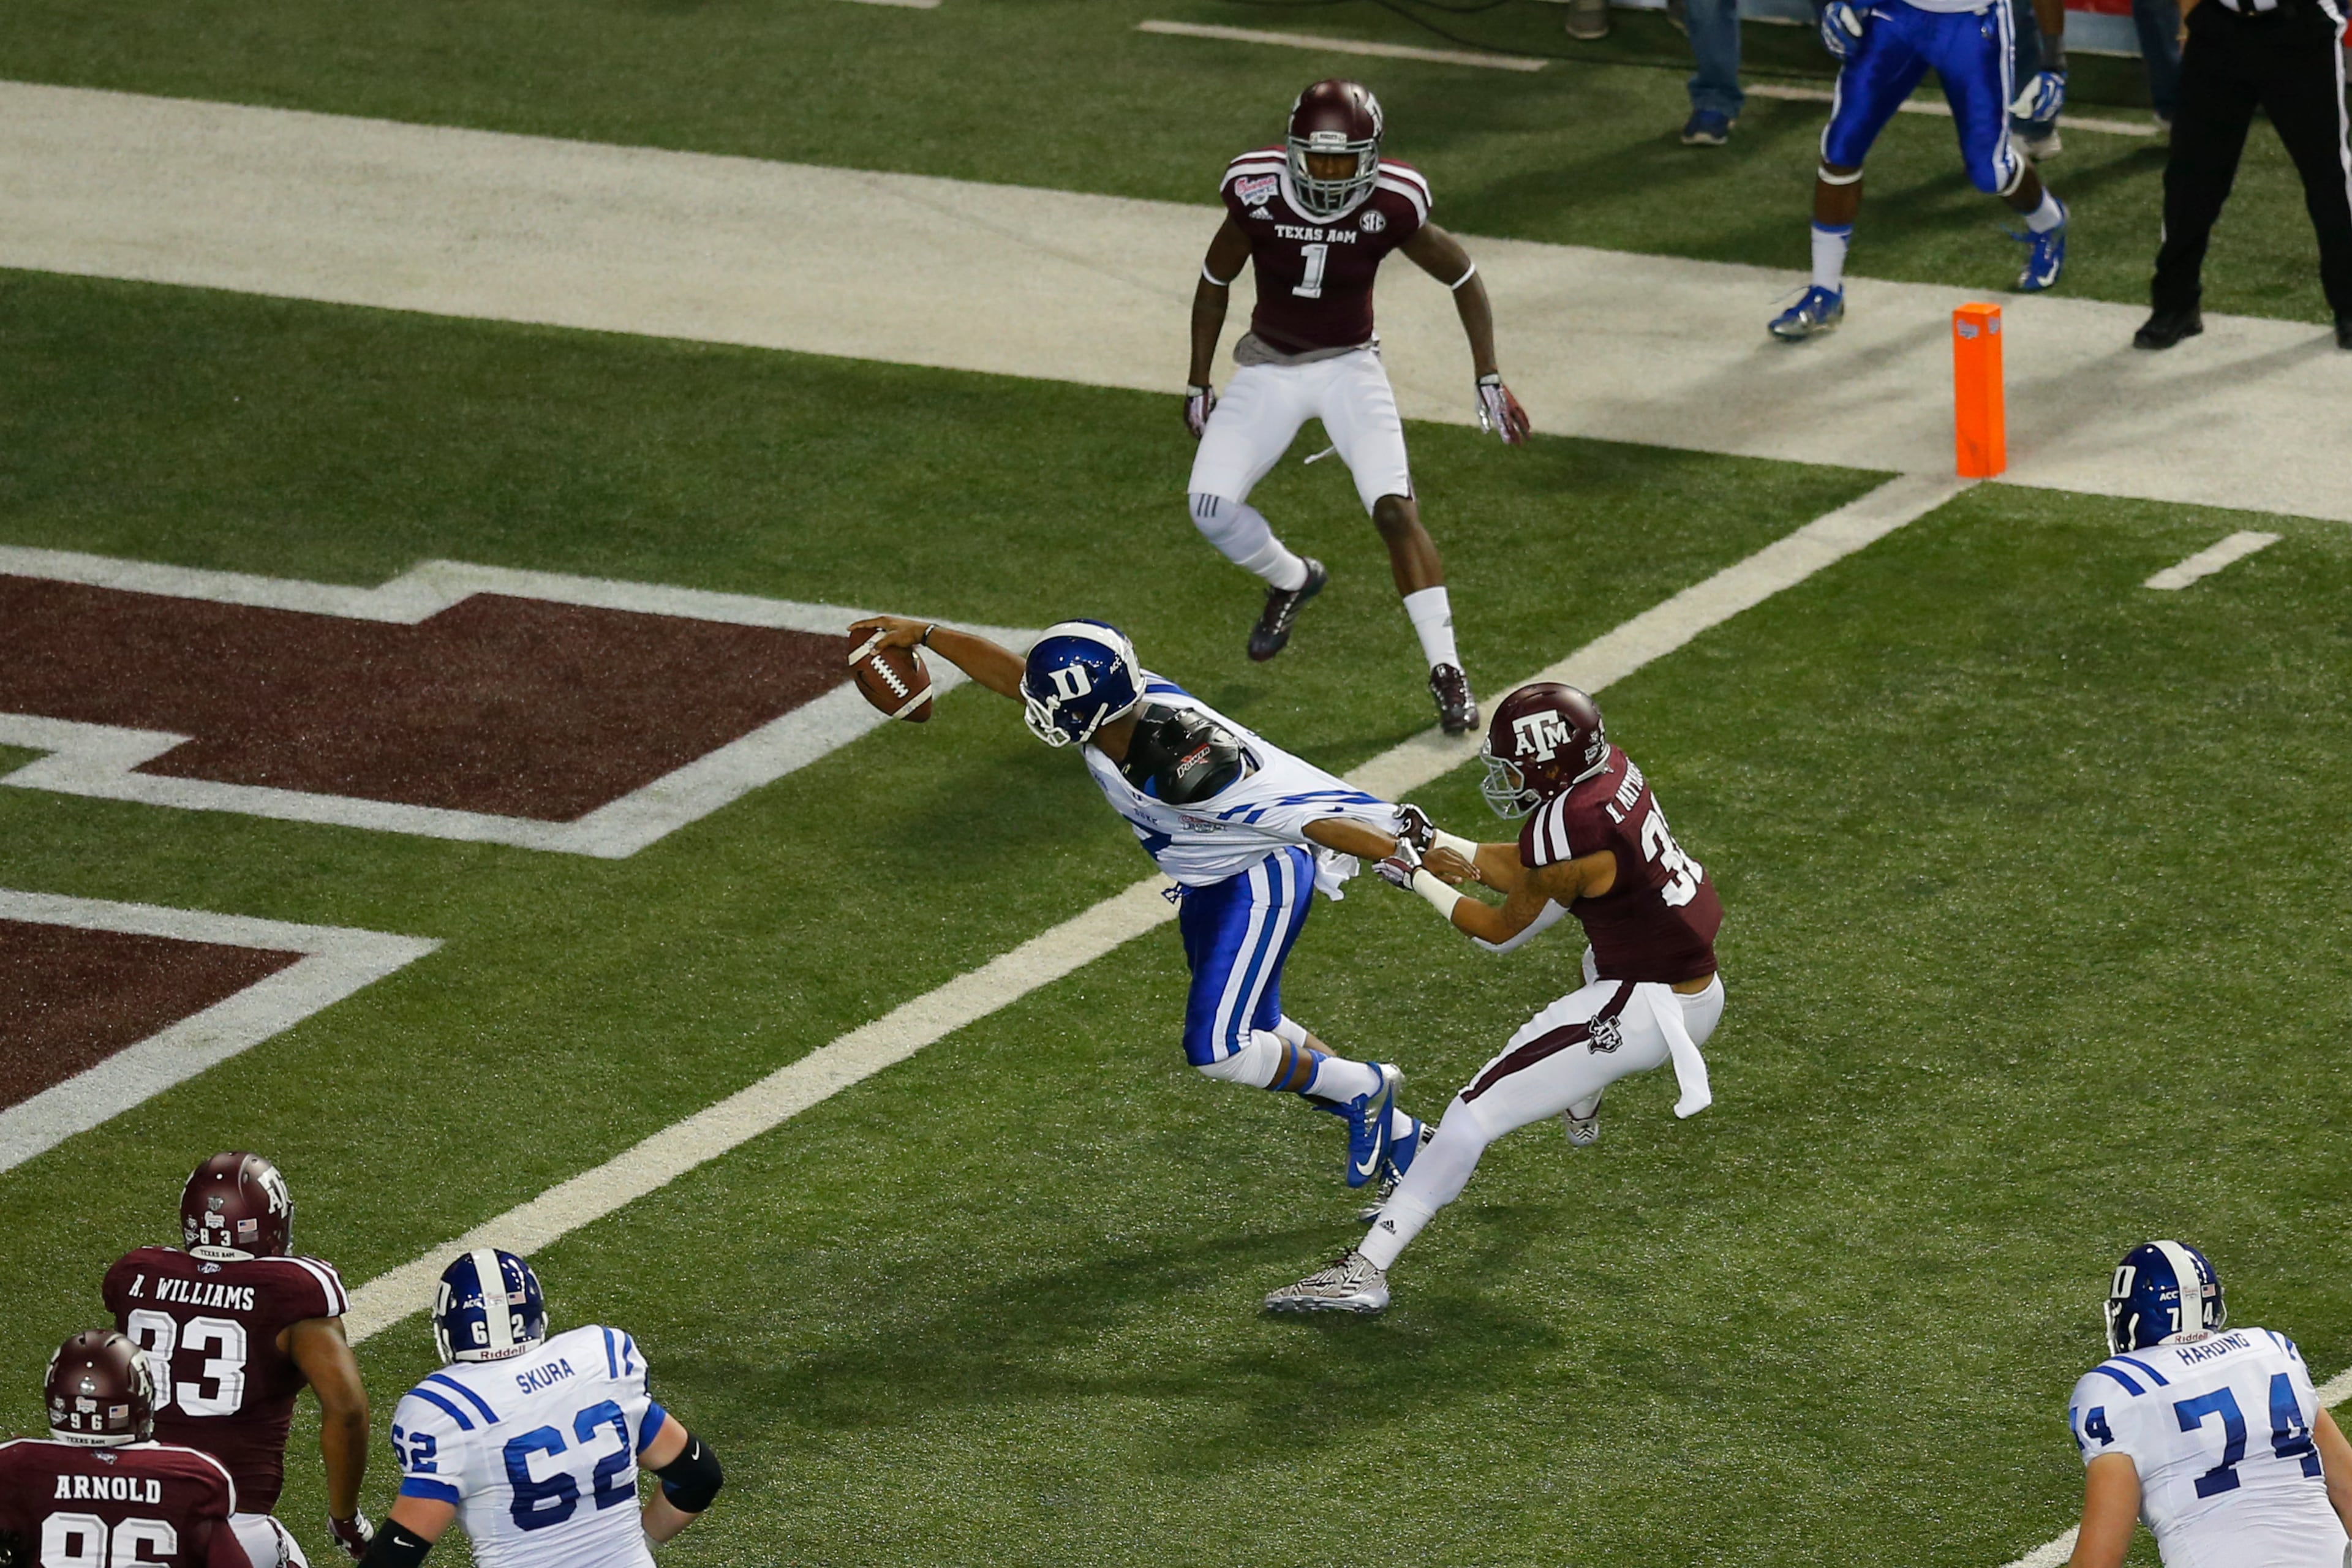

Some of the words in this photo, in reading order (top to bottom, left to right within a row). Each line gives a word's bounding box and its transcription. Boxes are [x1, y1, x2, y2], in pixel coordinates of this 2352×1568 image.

[1275, 224, 1323, 241] TEXAS
[1326, 229, 1357, 244] A&M
[1362, 212, 1384, 232] SEC
[1292, 244, 1329, 299] 1
[1048, 665, 1091, 701] D
[129, 1273, 145, 1298] A.
[156, 1277, 255, 1311] WILLIAMS
[2159, 1290, 2179, 1302] ACC
[480, 1344, 526, 1360] Riddell
[2174, 1332, 2209, 1344] Riddell
[2176, 1333, 2251, 1366] HARDING
[127, 1308, 247, 1417] 83
[516, 1358, 575, 1395] SKURA
[391, 1423, 437, 1473] 62
[2173, 1372, 2322, 1499] 74
[503, 1399, 636, 1532] 62
[54, 1475, 161, 1504] ARNOLD
